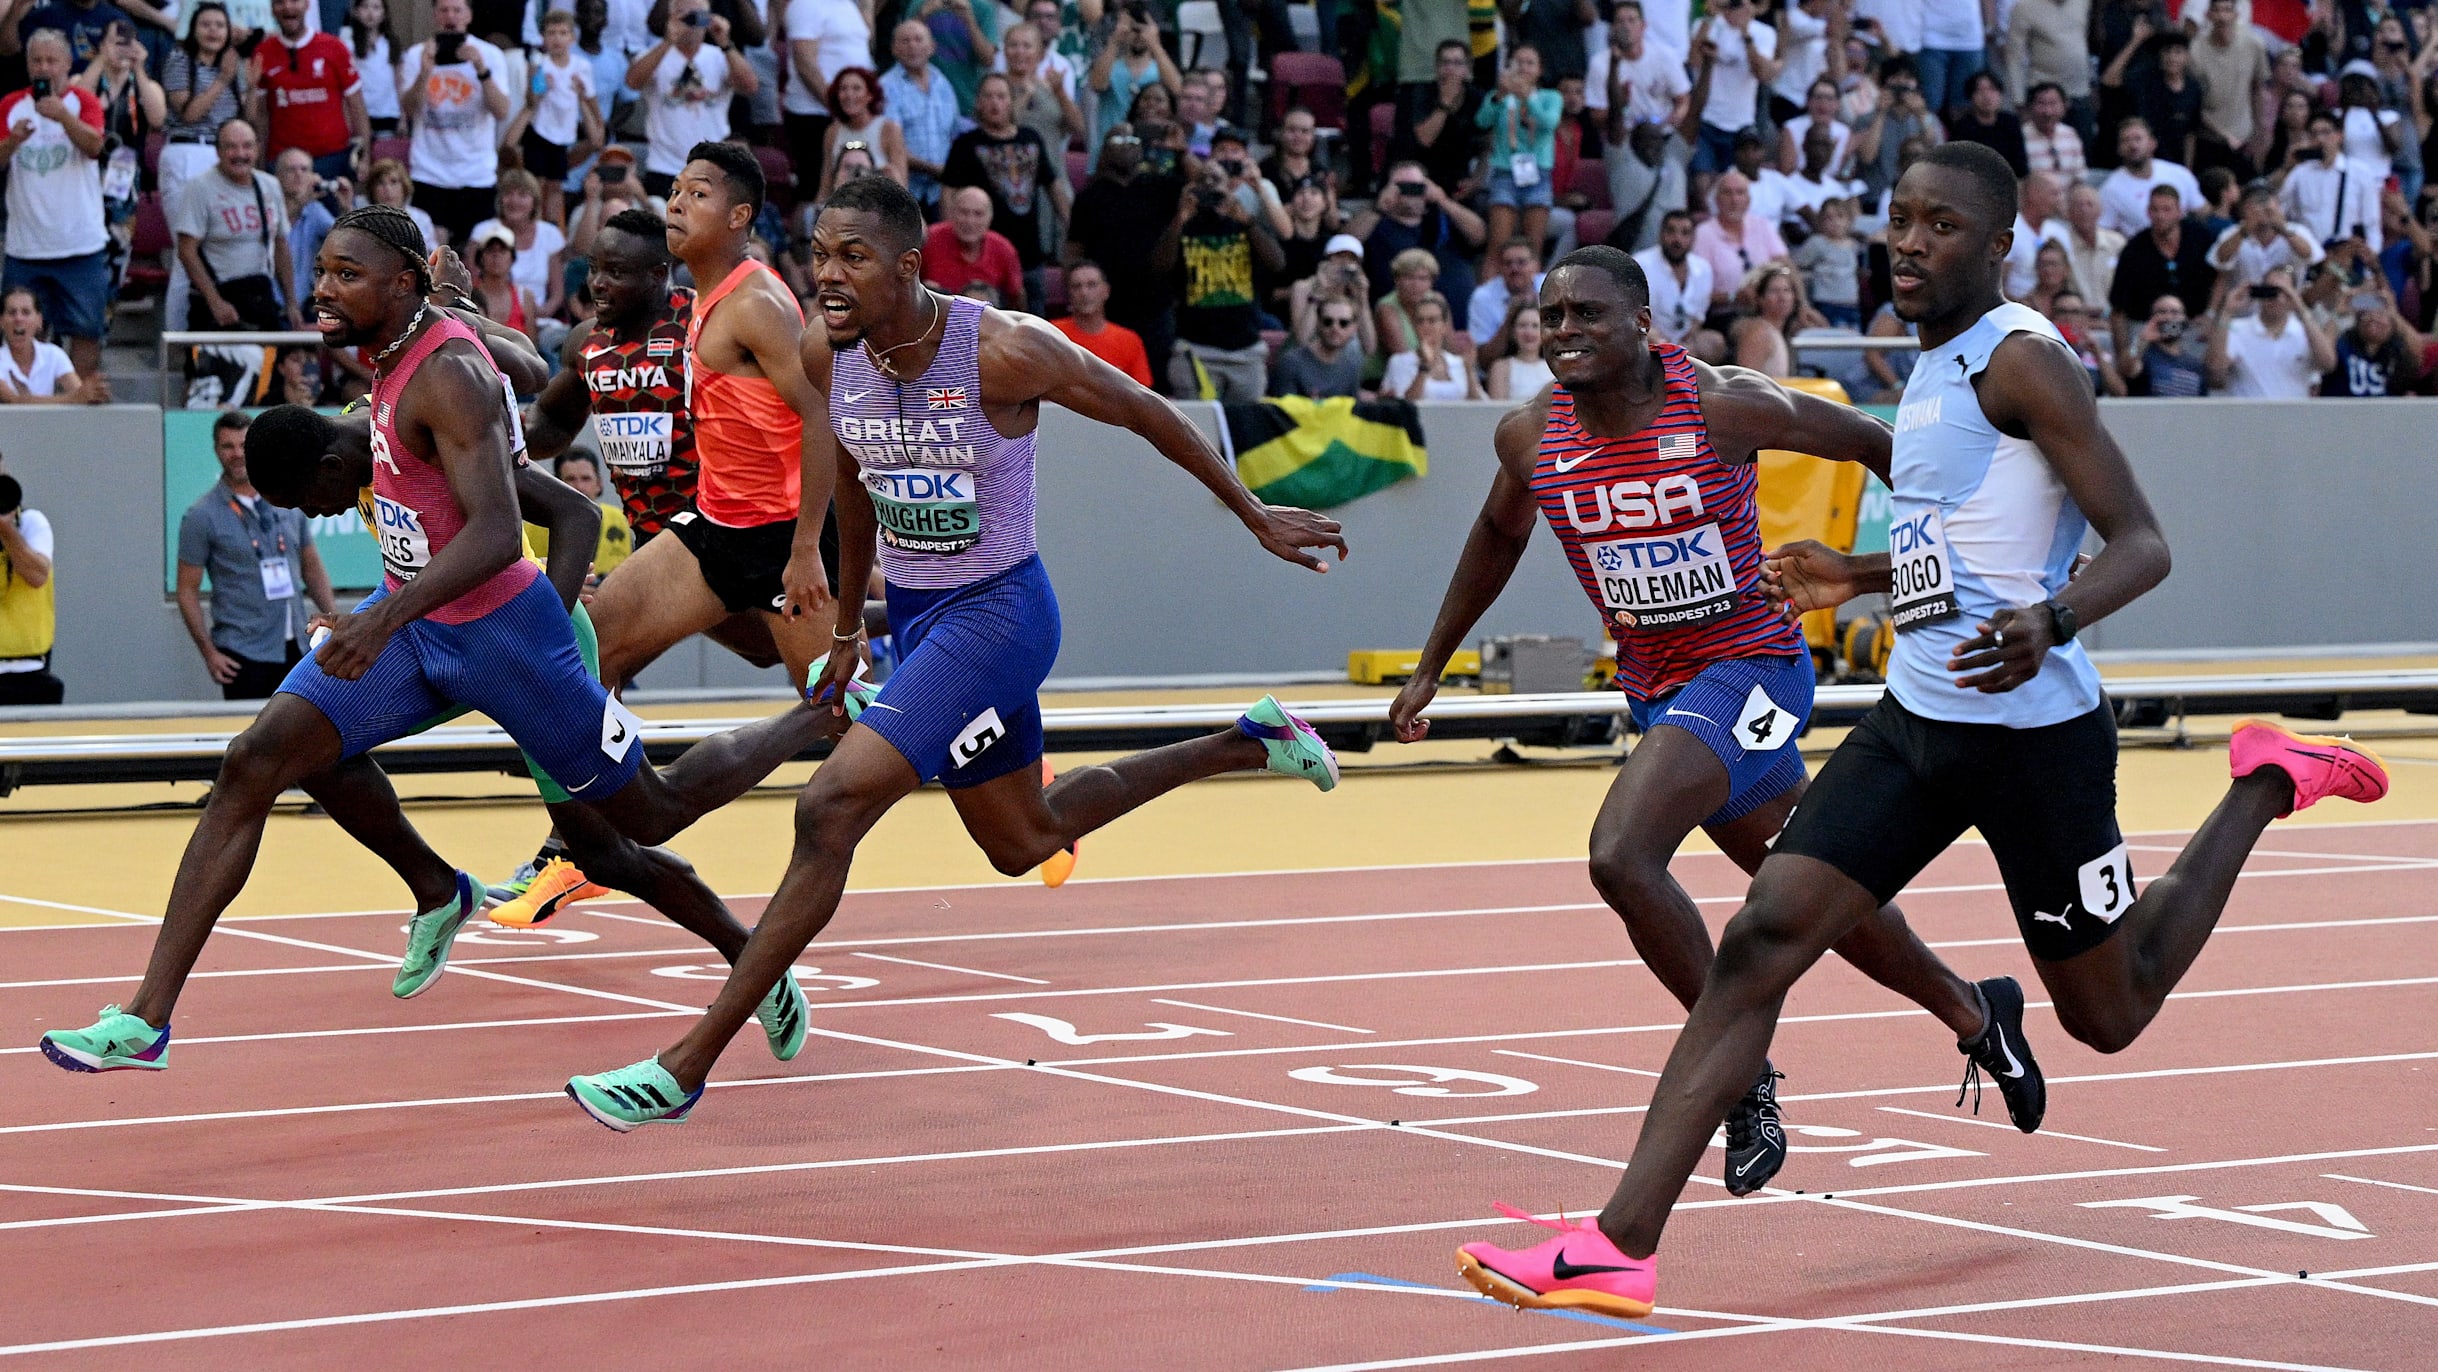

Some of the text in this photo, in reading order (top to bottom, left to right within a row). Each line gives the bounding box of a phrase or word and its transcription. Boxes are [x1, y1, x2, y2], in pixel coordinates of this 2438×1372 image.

[585, 366, 670, 392] KENYA
[611, 416, 664, 436] TDK
[841, 416, 965, 442] GREAT
[603, 441, 666, 461] OMANYALA
[850, 444, 976, 464] BRITAIN
[886, 473, 965, 499] TDK
[875, 500, 970, 532] HUGHES
[1562, 474, 1704, 534] USA
[1617, 530, 1713, 570] TDK
[1890, 513, 1936, 558] TDK
[1604, 562, 1727, 606] COLEMAN
[1747, 708, 1777, 743] 4
[959, 726, 998, 759] 5
[2099, 864, 2119, 912] 3
[988, 1012, 1236, 1045] 7
[1288, 1064, 1540, 1098] 6
[2074, 1195, 2378, 1240] 4
